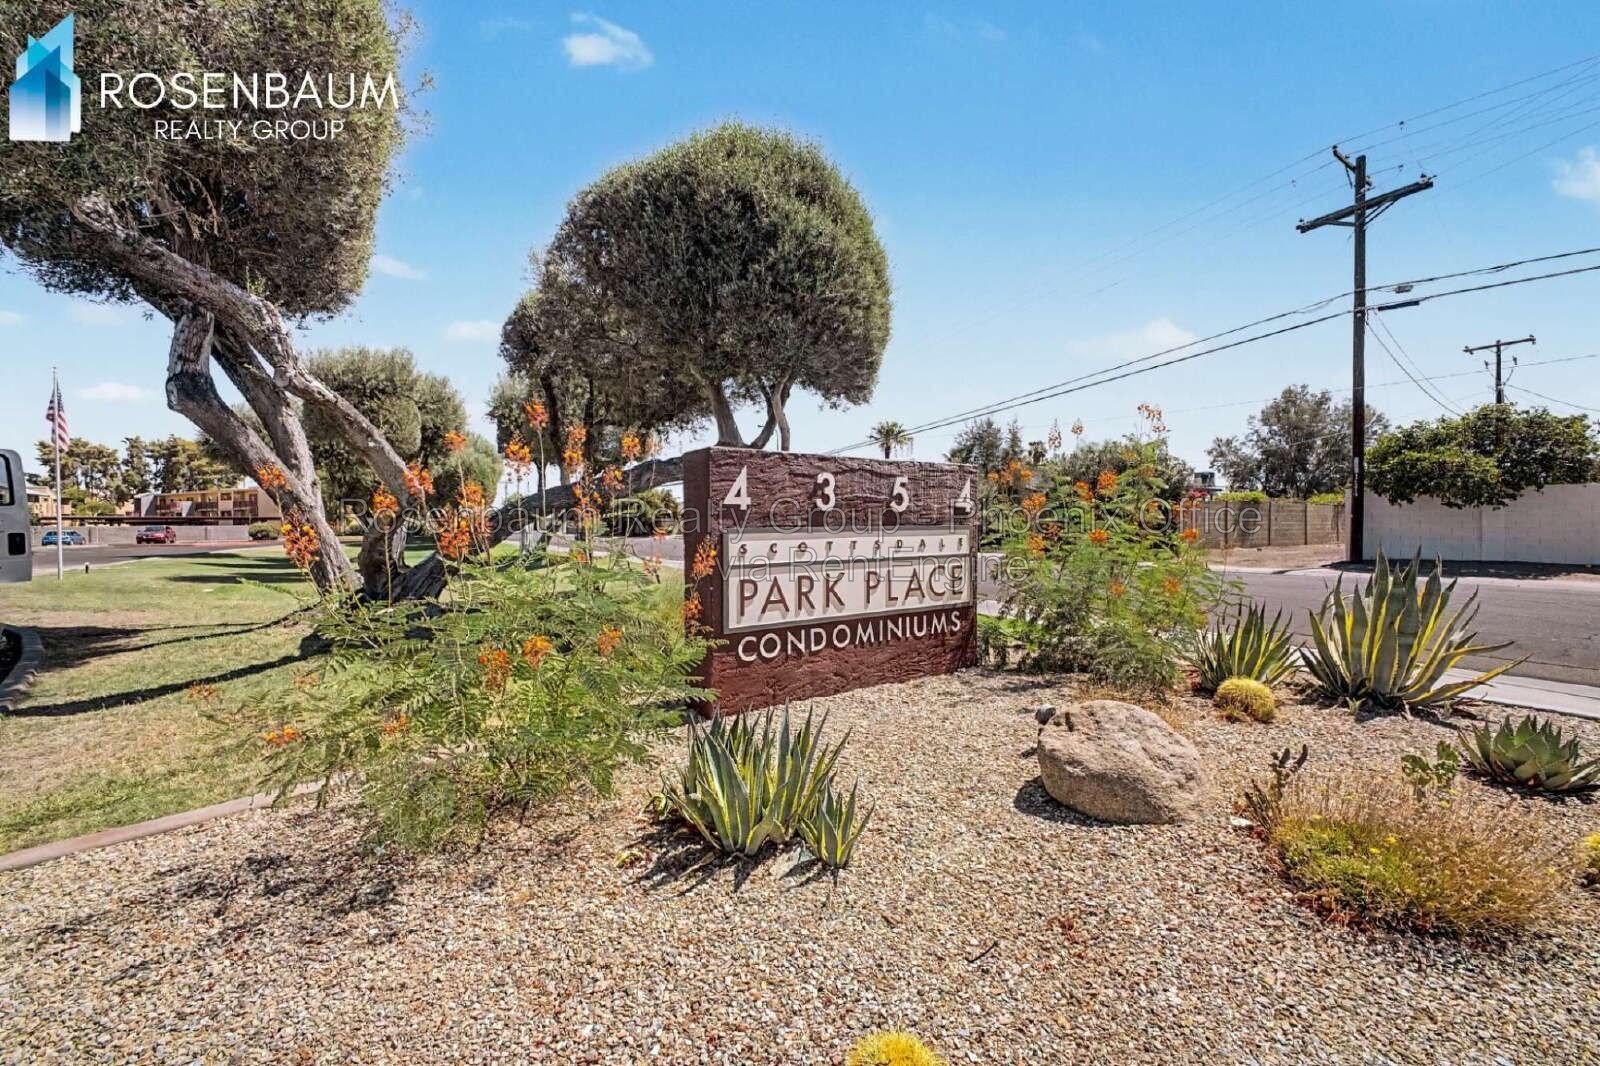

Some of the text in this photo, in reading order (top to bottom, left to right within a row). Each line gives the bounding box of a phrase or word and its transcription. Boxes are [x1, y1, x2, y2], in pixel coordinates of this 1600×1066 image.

[739, 536, 963, 555] SCOTTSDALE
[739, 564, 965, 618] PARK PLACE
[737, 610, 962, 662] CONDOMINIUMS
